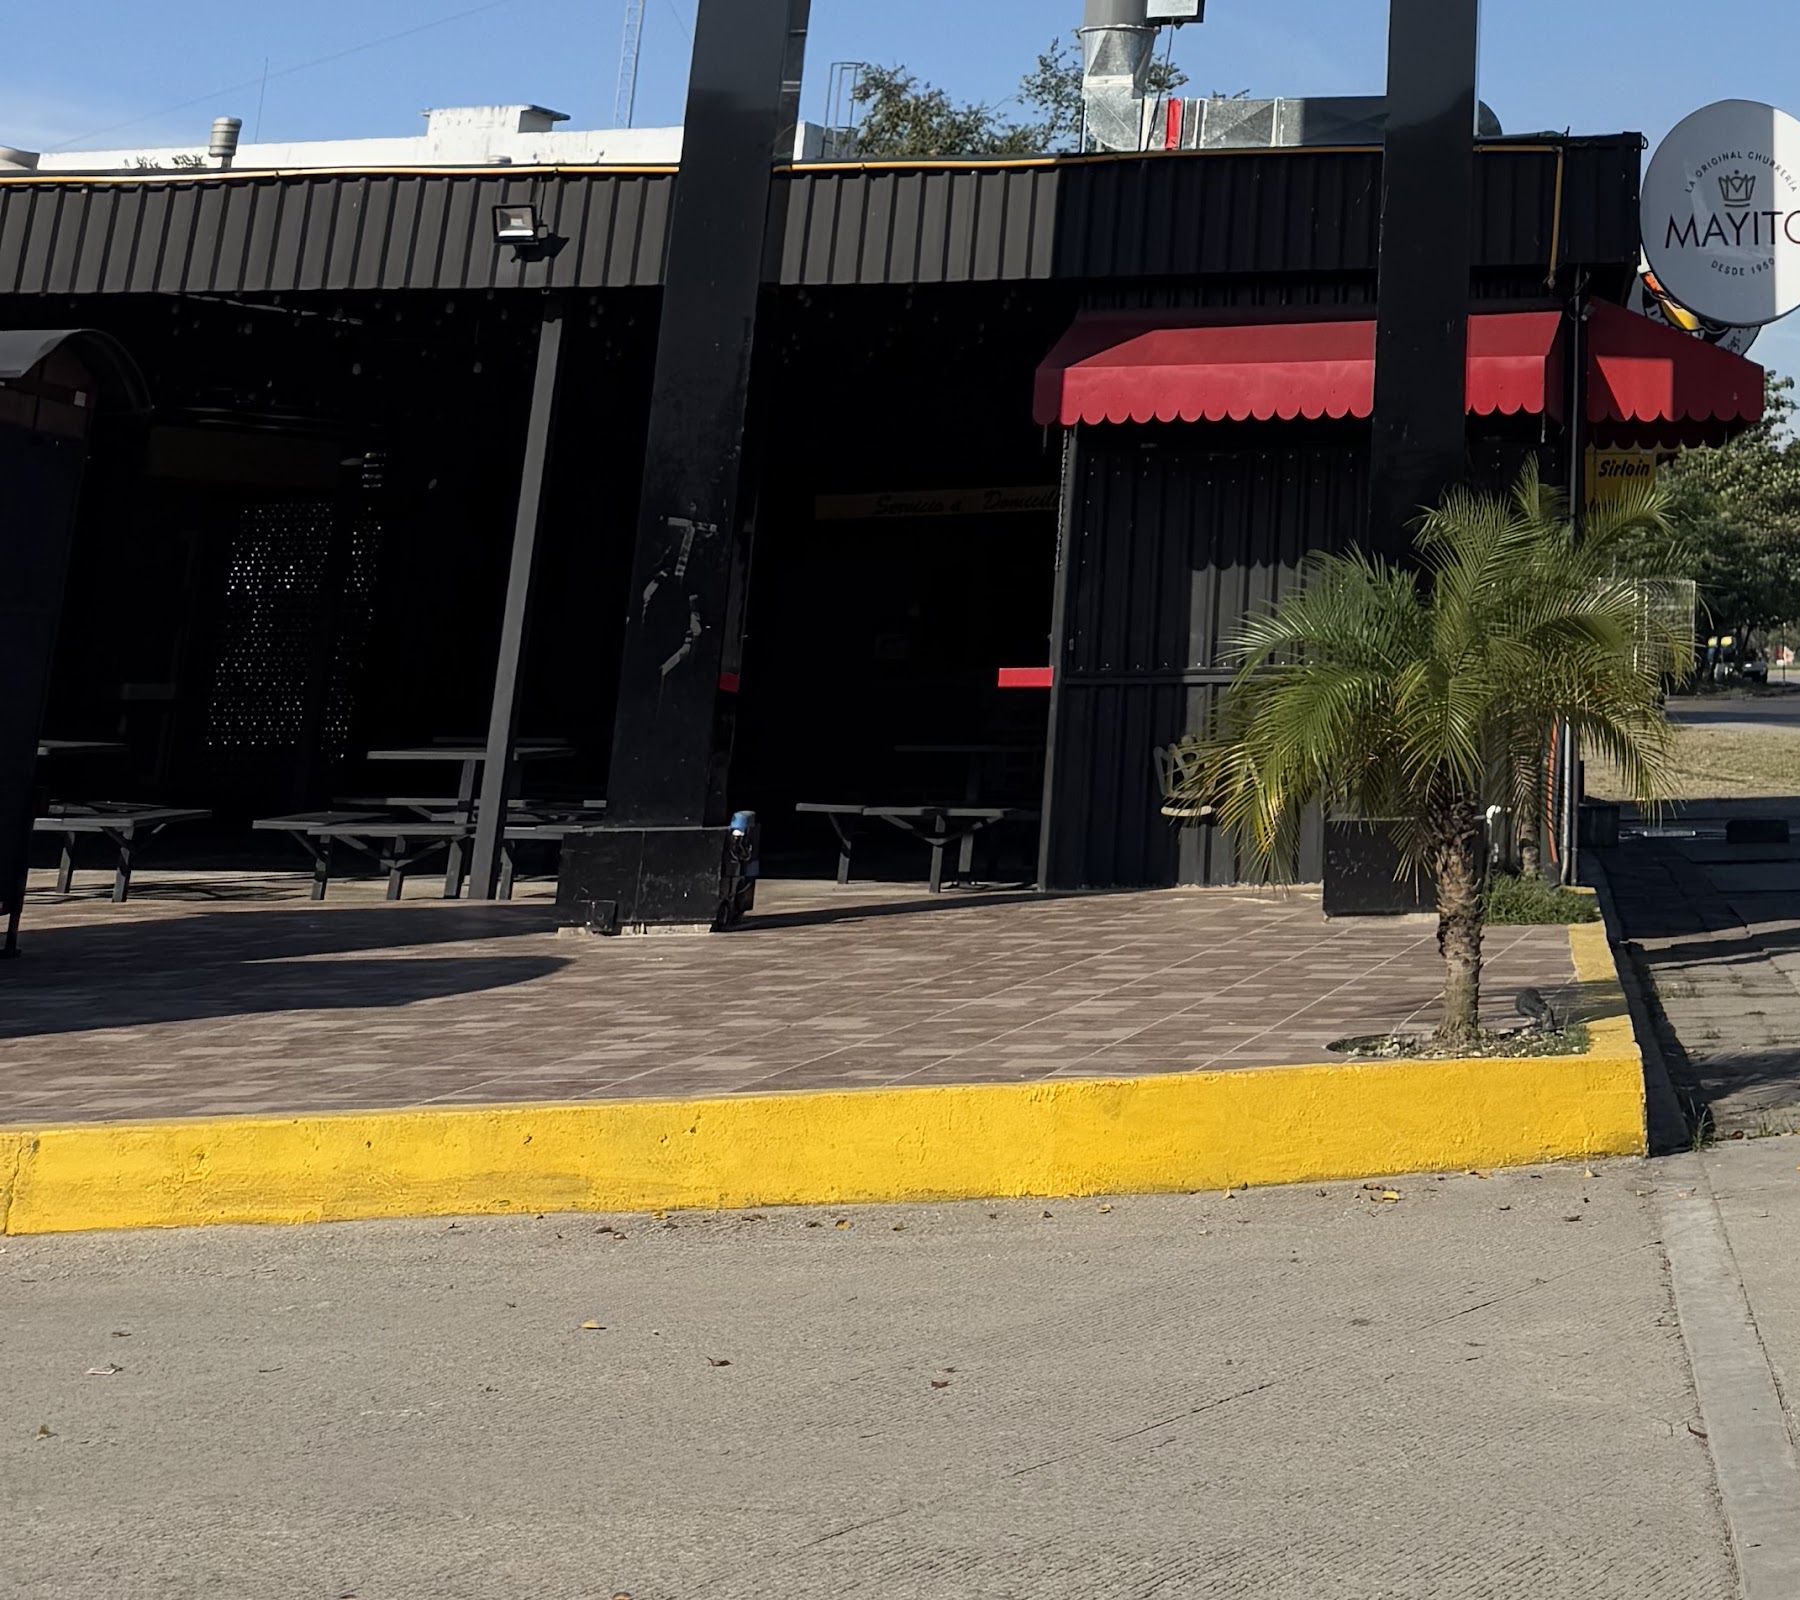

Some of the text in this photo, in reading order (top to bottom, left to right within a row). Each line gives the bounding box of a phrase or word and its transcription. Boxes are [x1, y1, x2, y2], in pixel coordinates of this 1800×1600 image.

[1684, 180, 1696, 194] LA
[1695, 151, 1743, 178] ORIGINAL
[1711, 260, 1745, 276] DESDE
[1598, 458, 1650, 478] Sirloin
